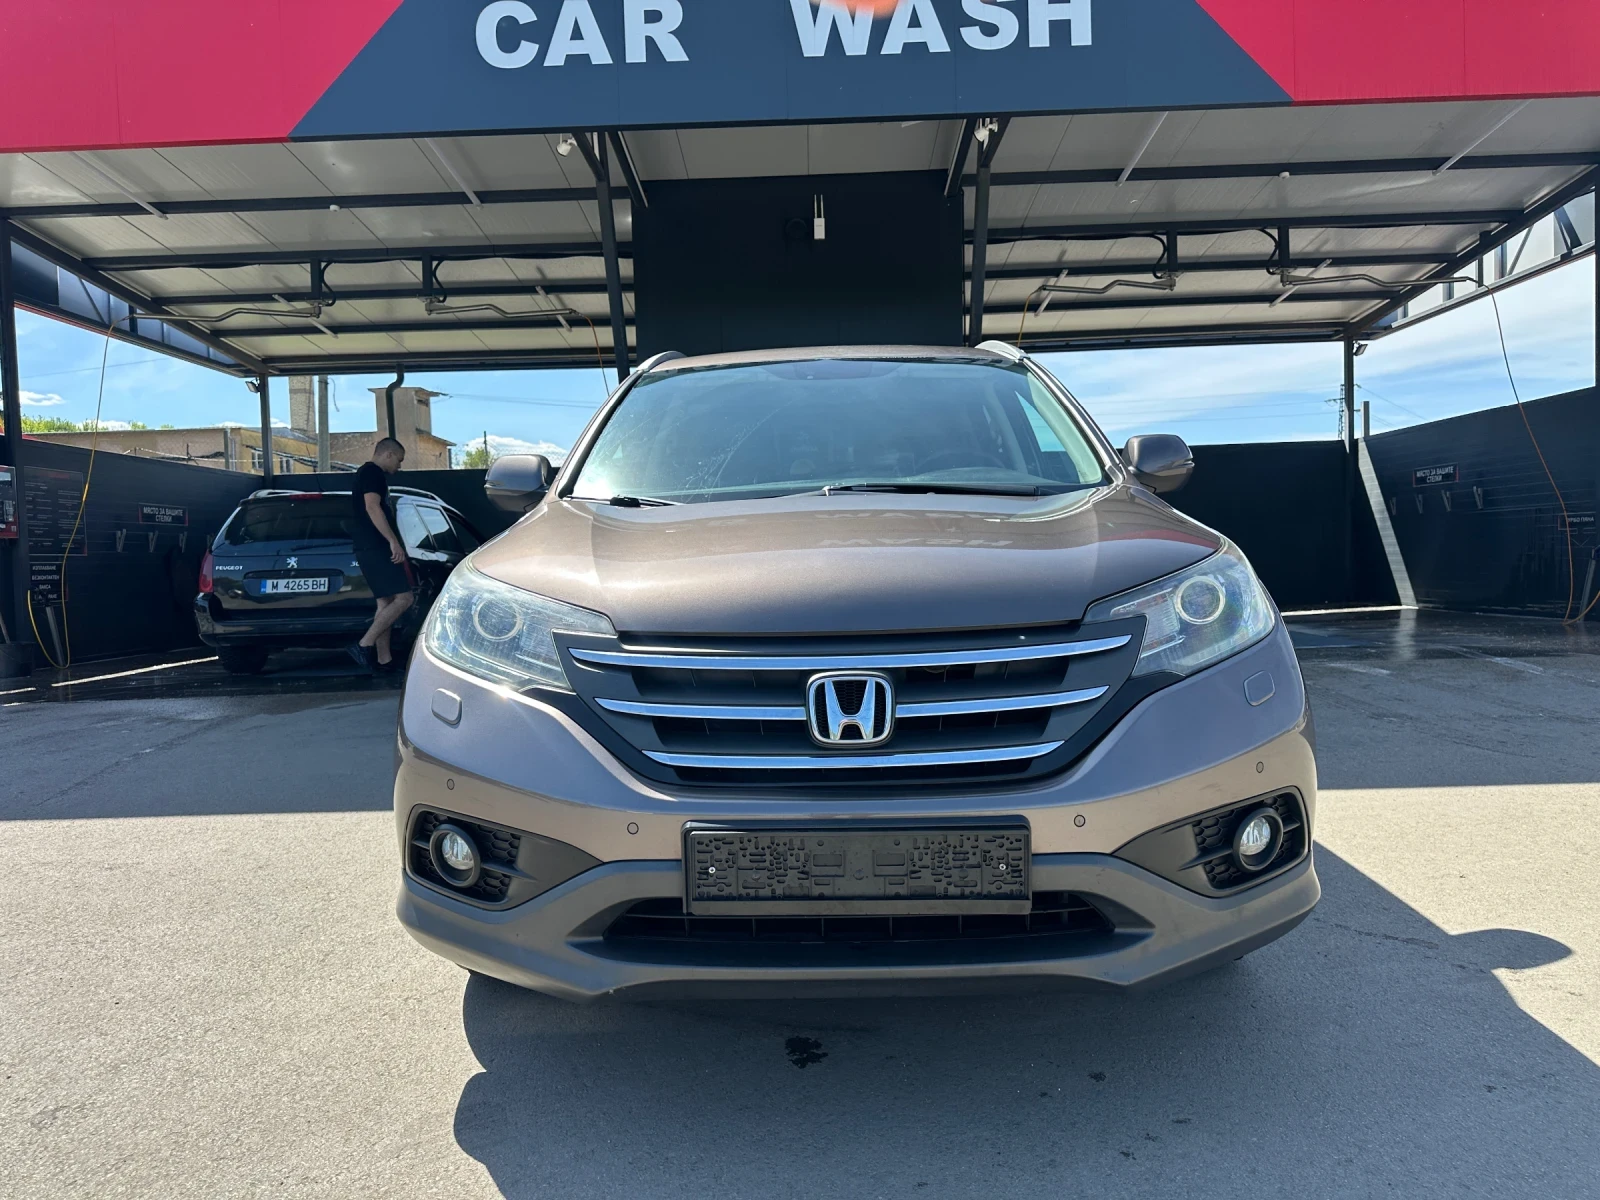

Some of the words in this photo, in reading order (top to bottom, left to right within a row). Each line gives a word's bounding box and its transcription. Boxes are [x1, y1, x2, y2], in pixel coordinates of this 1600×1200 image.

[474, 0, 690, 70] CAR
[788, 0, 1094, 58] WASH
[271, 581, 279, 591] M
[283, 580, 310, 591] 4265
[311, 579, 327, 590] BH
